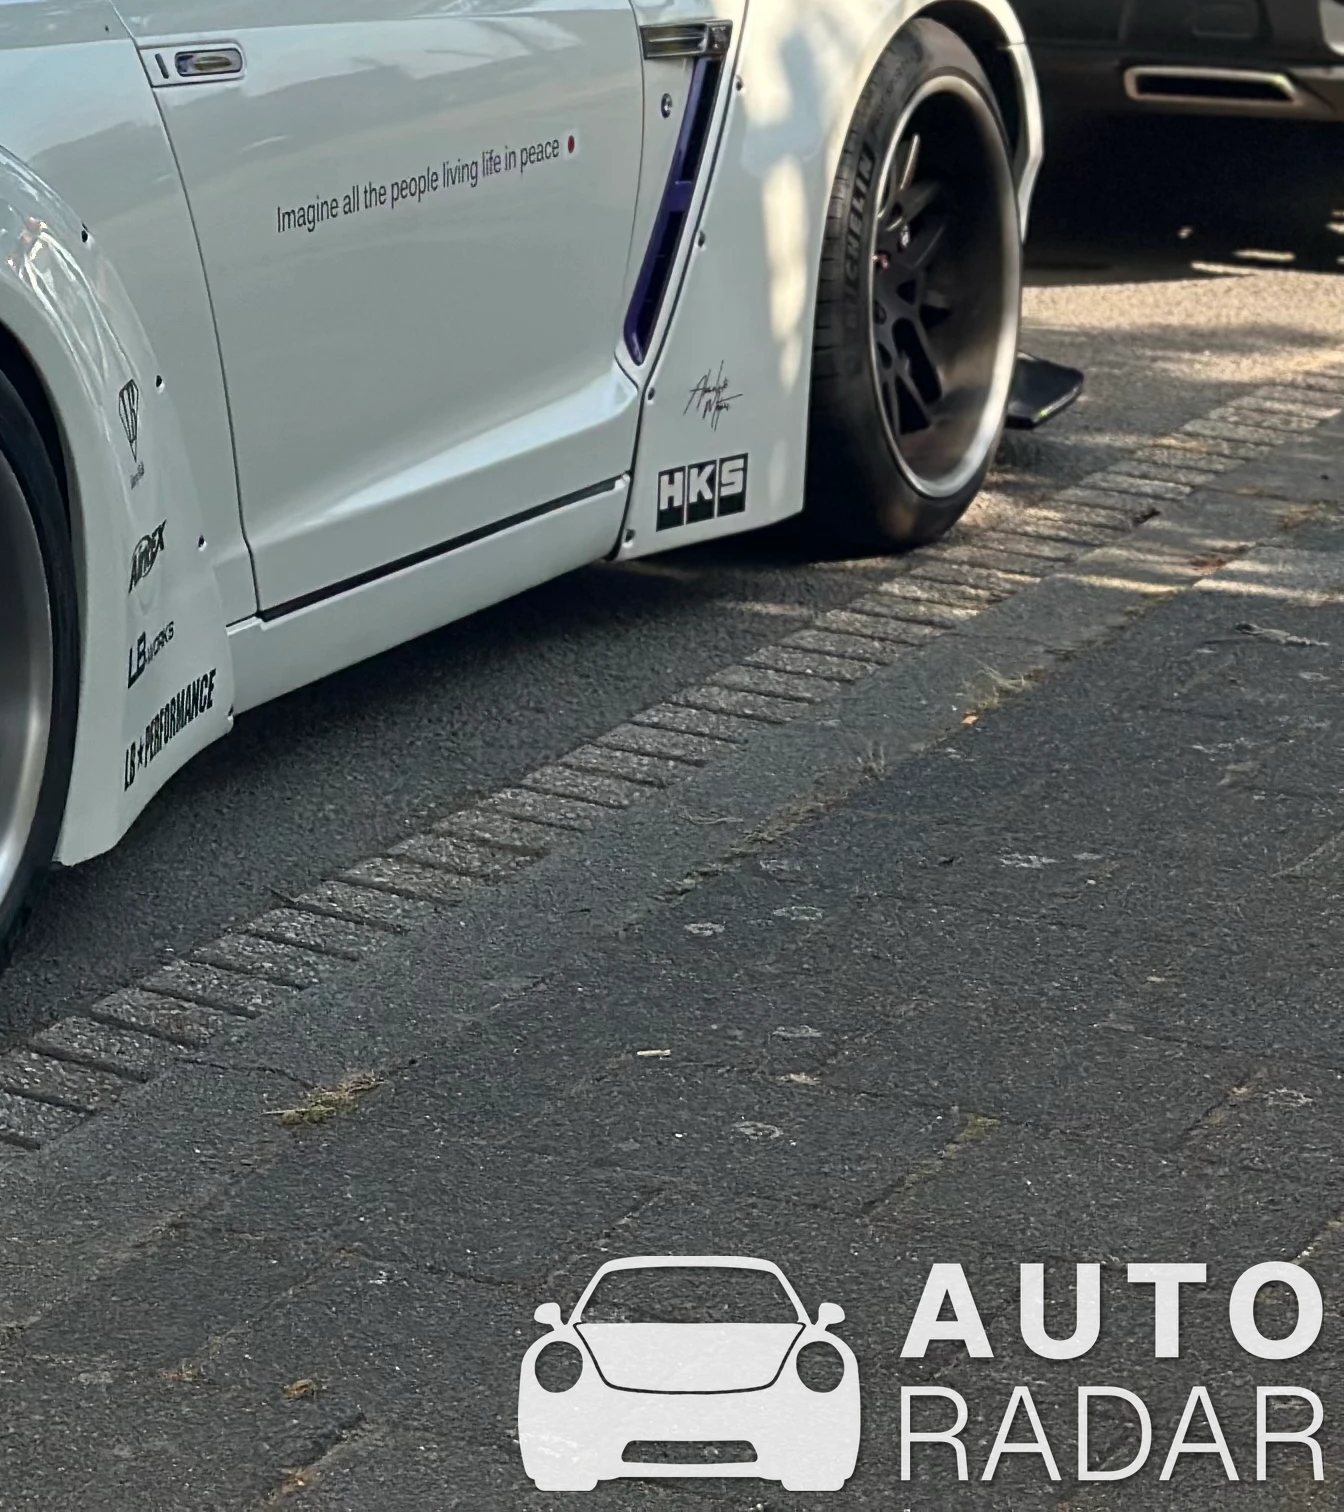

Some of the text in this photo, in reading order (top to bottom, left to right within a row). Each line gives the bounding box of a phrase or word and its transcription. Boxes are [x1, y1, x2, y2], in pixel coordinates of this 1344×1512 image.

[277, 137, 560, 233] Imagine all the people living life in peace
[656, 453, 748, 522] HKS
[144, 667, 217, 768] PERFORMANCE
